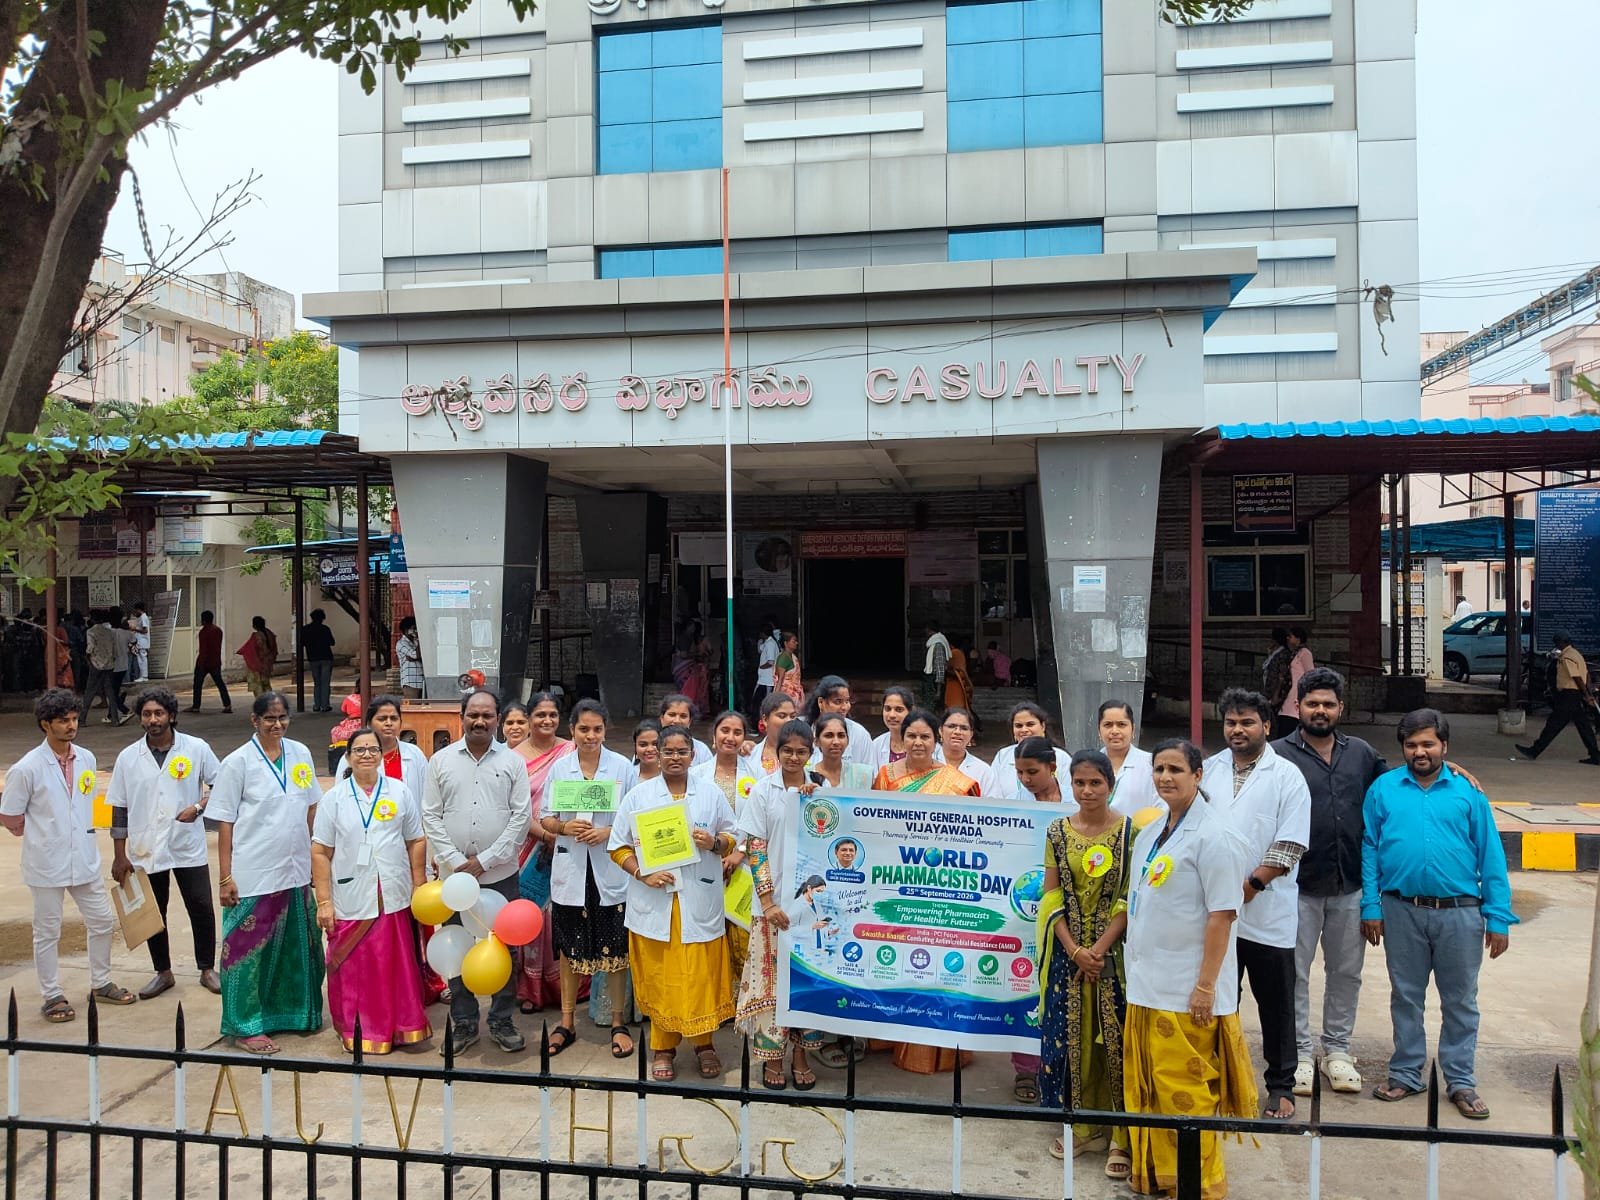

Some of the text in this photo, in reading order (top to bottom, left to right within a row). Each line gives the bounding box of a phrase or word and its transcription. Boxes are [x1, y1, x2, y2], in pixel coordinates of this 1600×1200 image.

[865, 353, 1146, 403] CASUALTY
[801, 535, 832, 544] EMERGENCY
[858, 534, 890, 543] DEPARTMENT
[853, 807, 1035, 829] GOVERNMENT GENERAL HOSPITAL
[905, 822, 983, 837] VIJAYAWADA
[882, 831, 907, 841] Pharmacy
[949, 835, 974, 844] Healthier
[975, 838, 1004, 848] Community
[898, 845, 989, 870] WORLD
[872, 865, 1013, 896] PHARMACISTS DAY
[838, 888, 867, 900] Welcome
[906, 887, 919, 895] 25th
[920, 888, 955, 898] September
[854, 896, 862, 905] all
[900, 913, 912, 921] for
[914, 914, 948, 924] Healthier
[945, 909, 990, 920] Pharmacists
[861, 930, 885, 938] Swastha
[906, 934, 934, 944] Combating
[935, 937, 969, 946] Antimicrobial
[970, 940, 998, 949] Resistance
